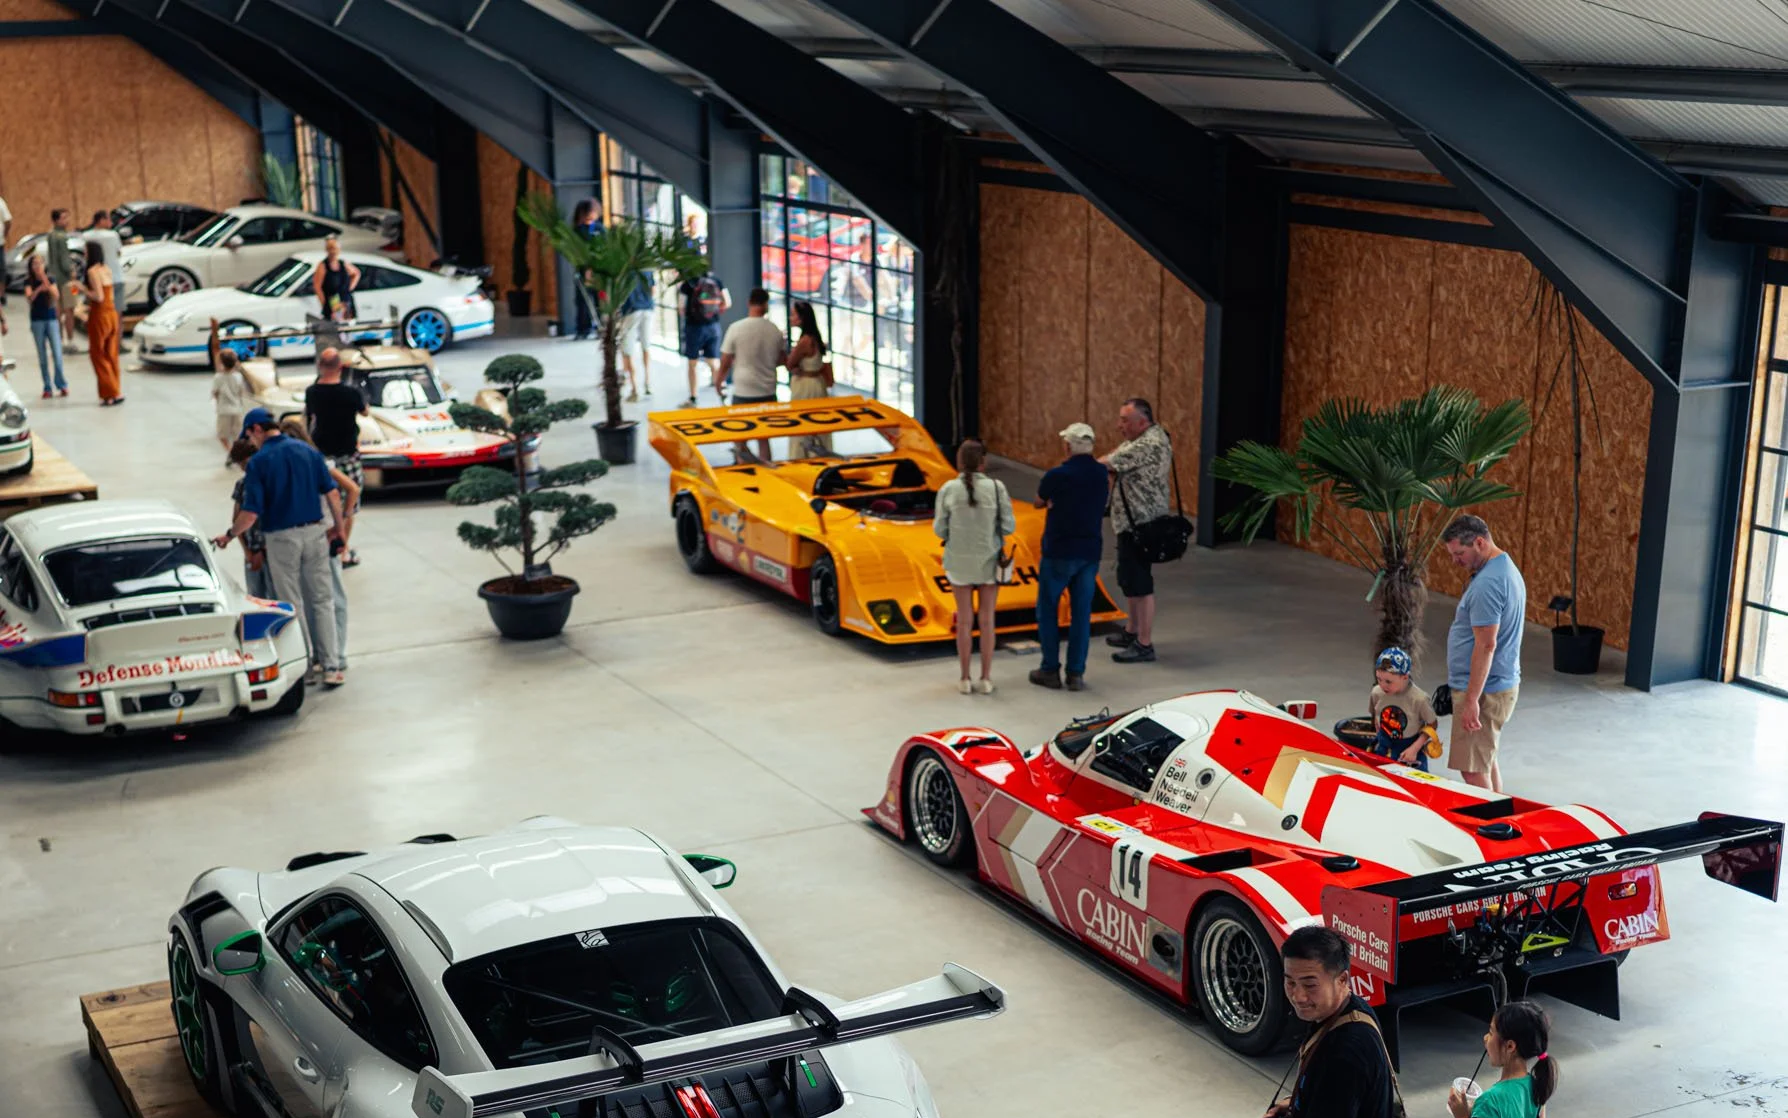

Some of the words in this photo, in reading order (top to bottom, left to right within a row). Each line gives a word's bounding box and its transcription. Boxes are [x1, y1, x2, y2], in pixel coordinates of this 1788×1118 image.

[672, 406, 886, 437] BOSCH
[77, 663, 163, 688] Defense
[1166, 766, 1187, 782] Bell
[1156, 790, 1192, 813] Weaver
[1524, 842, 1614, 866] Racing
[1118, 844, 1144, 900] 14
[1453, 859, 1524, 879] Team
[1077, 888, 1146, 958] CABIN
[1413, 906, 1454, 923] PORSCHE
[1456, 900, 1480, 916] CARS
[1332, 913, 1367, 943] Porsche
[1369, 931, 1389, 954] Cars
[1604, 910, 1659, 940] CABIN
[1359, 945, 1388, 972] Britain
